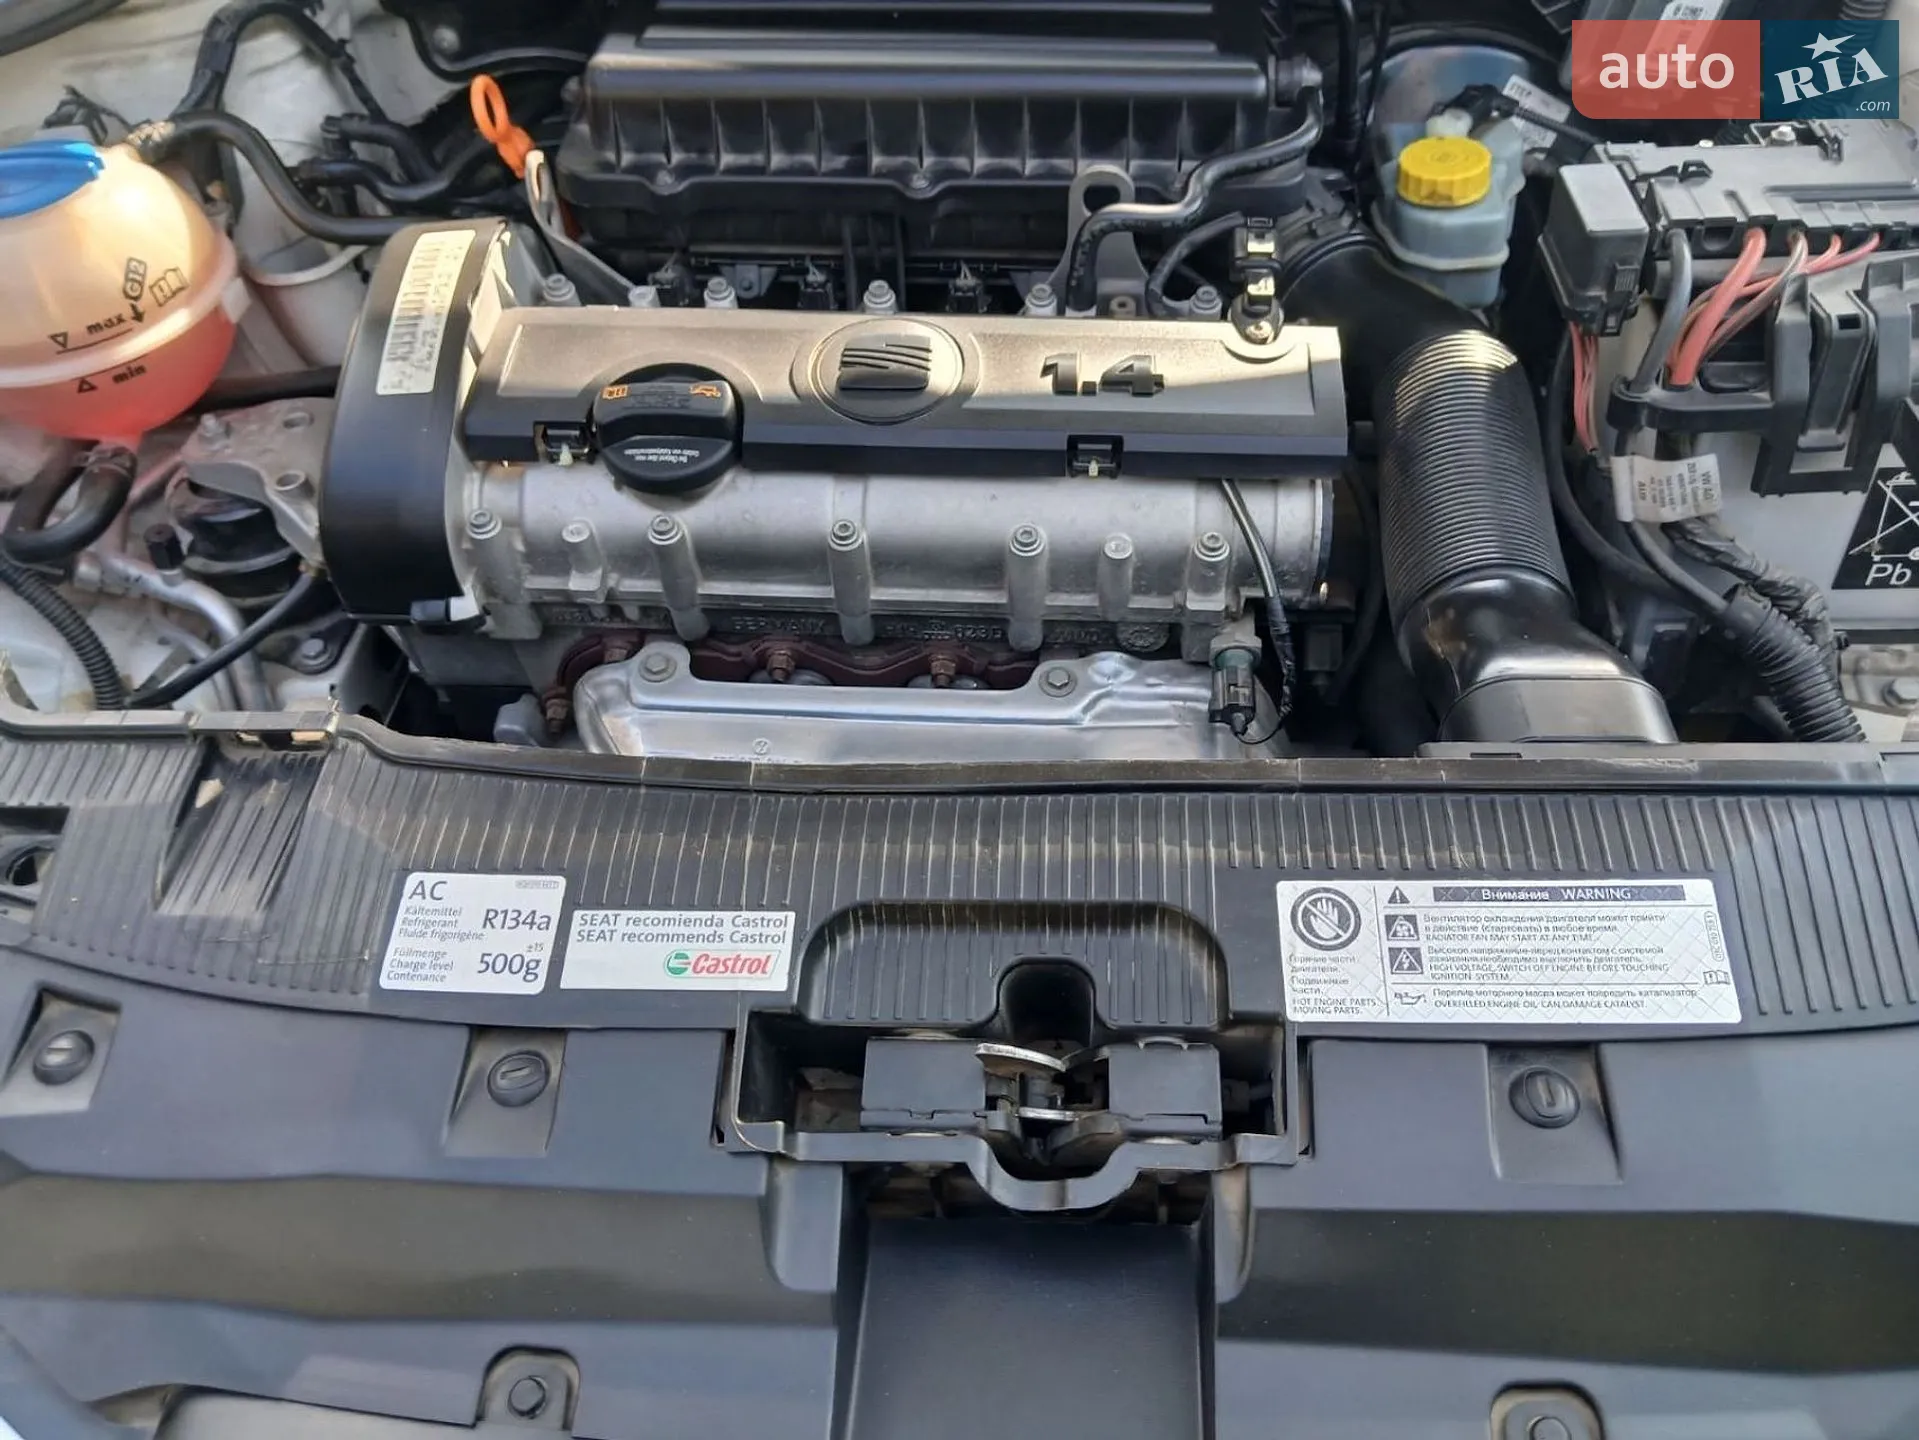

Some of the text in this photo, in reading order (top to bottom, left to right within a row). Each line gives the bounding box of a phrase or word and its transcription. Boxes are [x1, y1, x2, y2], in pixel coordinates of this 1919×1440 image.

[86, 313, 126, 336] max
[112, 364, 147, 386] min
[1040, 352, 1166, 397] 1.4
[1865, 563, 1912, 586] Pb
[408, 880, 448, 900] AC
[1482, 888, 1632, 900] Внимание WARNING
[404, 906, 462, 917] Kältemittel
[401, 917, 458, 929] Refrigerant
[482, 908, 551, 931] R134a
[579, 913, 788, 929] SEAT recomienda Castrol
[398, 928, 486, 942] Fluide frigorigène
[576, 929, 786, 945] SEAT recommends Castrol
[393, 947, 447, 961] Füllmenge
[389, 959, 453, 971] Charge level
[477, 953, 542, 983] 500g
[691, 952, 772, 976] Castrol
[387, 971, 447, 982] Contenance
[1431, 972, 1471, 980] IGNITION
[1293, 998, 1311, 1006] HOT
[1314, 998, 1347, 1006] ENGINE
[1434, 1000, 1485, 1008] OVERFILLED
[1488, 1000, 1520, 1008] ENGINE
[1293, 1006, 1331, 1014] MOVING
